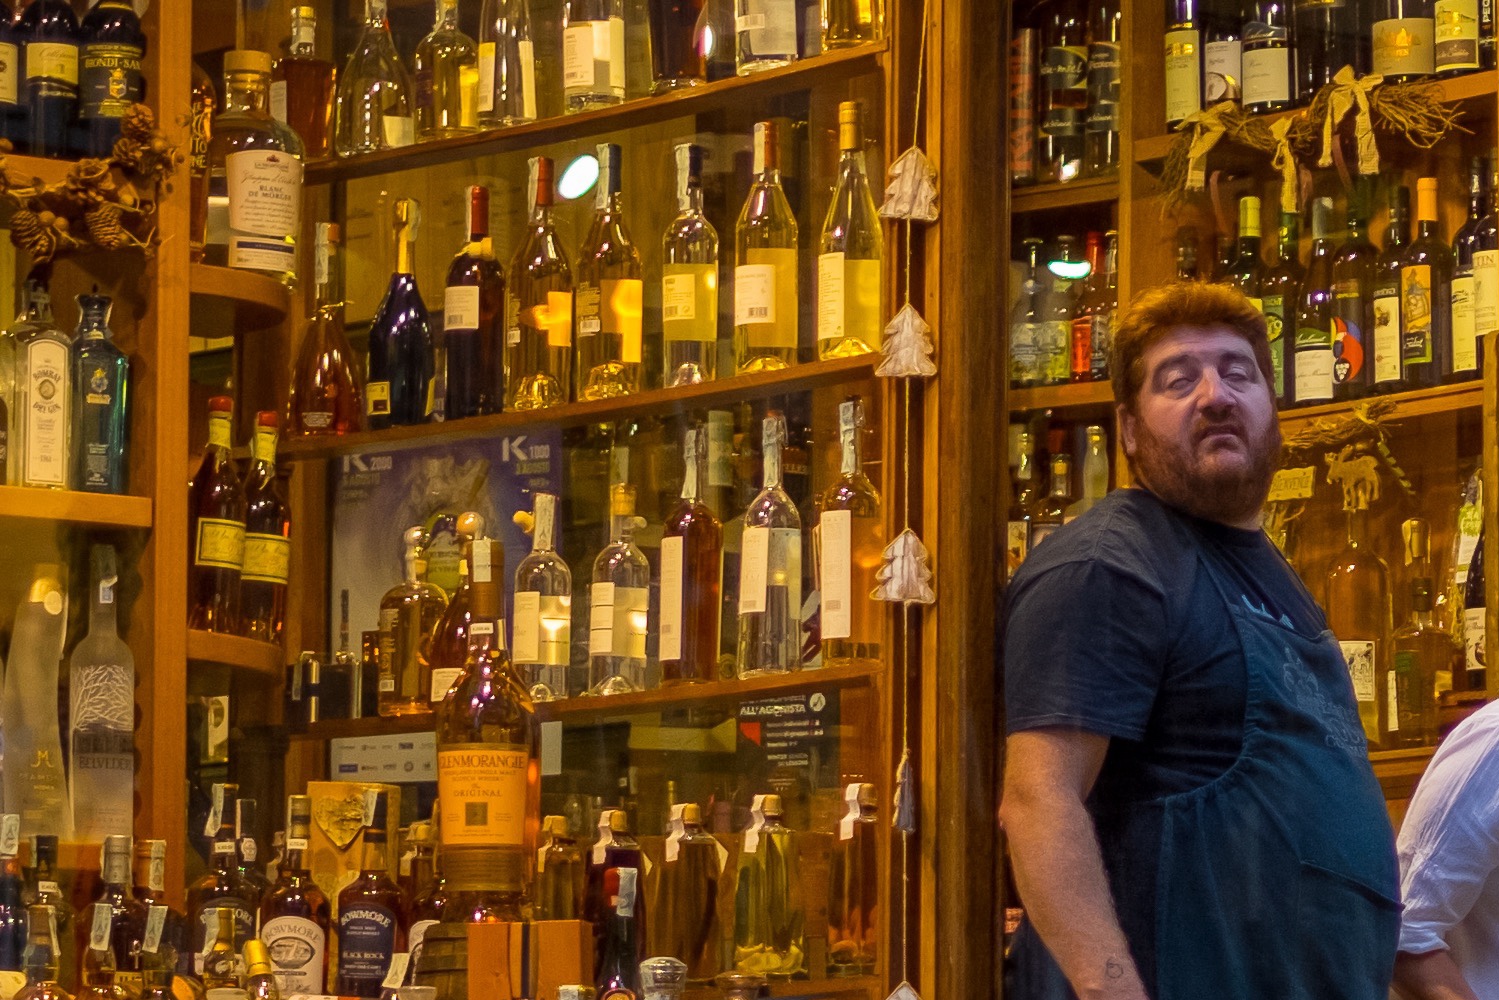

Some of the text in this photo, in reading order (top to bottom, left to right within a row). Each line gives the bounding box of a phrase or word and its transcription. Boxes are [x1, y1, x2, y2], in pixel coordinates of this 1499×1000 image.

[502, 436, 528, 462] K
[370, 456, 393, 470] 2000
[453, 789, 503, 798] ORIGINAL
[341, 909, 392, 928] BOWMORE
[265, 924, 322, 944] BOWMORE
